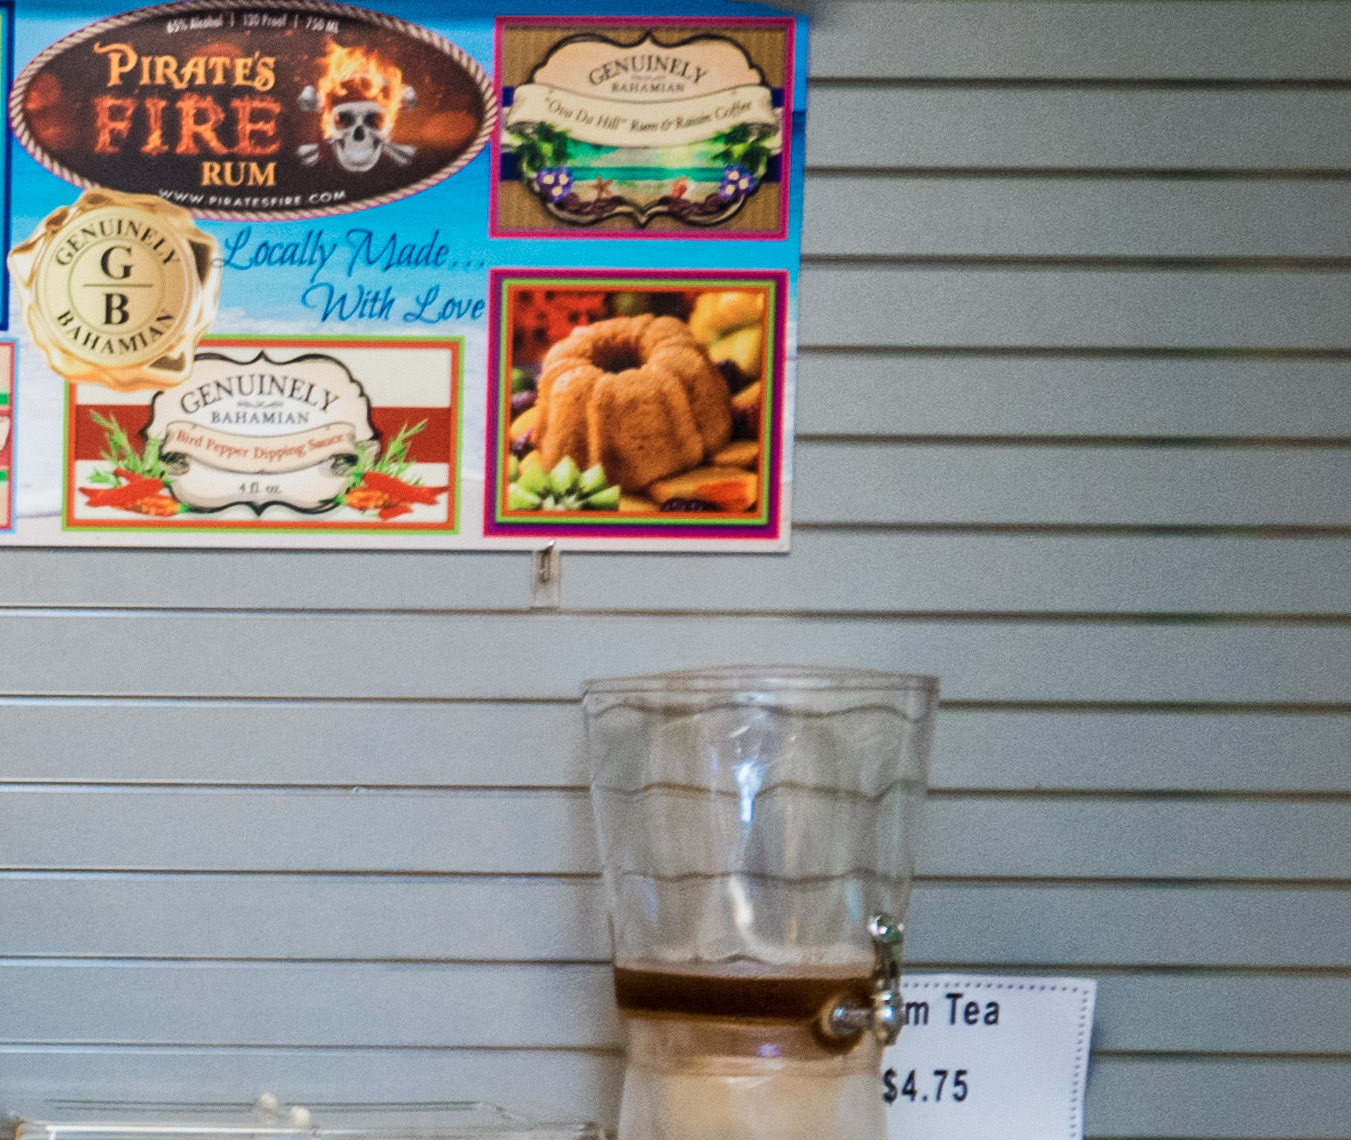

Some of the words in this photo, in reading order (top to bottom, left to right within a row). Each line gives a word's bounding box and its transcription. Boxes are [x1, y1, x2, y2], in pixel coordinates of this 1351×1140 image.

[588, 54, 708, 86] GENUINELY
[611, 81, 686, 93] BAHAMIAN
[94, 96, 282, 157] FIRE
[576, 109, 594, 124] Da
[630, 121, 659, 132] Rum
[714, 99, 753, 121] Coffee
[201, 161, 277, 187] RUM
[55, 218, 181, 268] GENUINELY
[213, 226, 337, 283] Locally
[346, 228, 486, 277] Made...
[99, 244, 133, 281] G
[102, 292, 131, 327] B
[301, 282, 395, 323] With
[402, 284, 486, 323] Love
[55, 308, 176, 355] BAHAMIAN
[179, 374, 341, 415] GENUINELY
[211, 411, 311, 425] BAHAMIAN
[176, 430, 203, 447] Bird
[206, 438, 249, 459] Pepper
[253, 444, 306, 462] Dipping
[308, 434, 345, 450] Sauce
[239, 483, 247, 494] 4
[945, 992, 1000, 1026] Tea
[883, 1067, 969, 1103] $4.75
